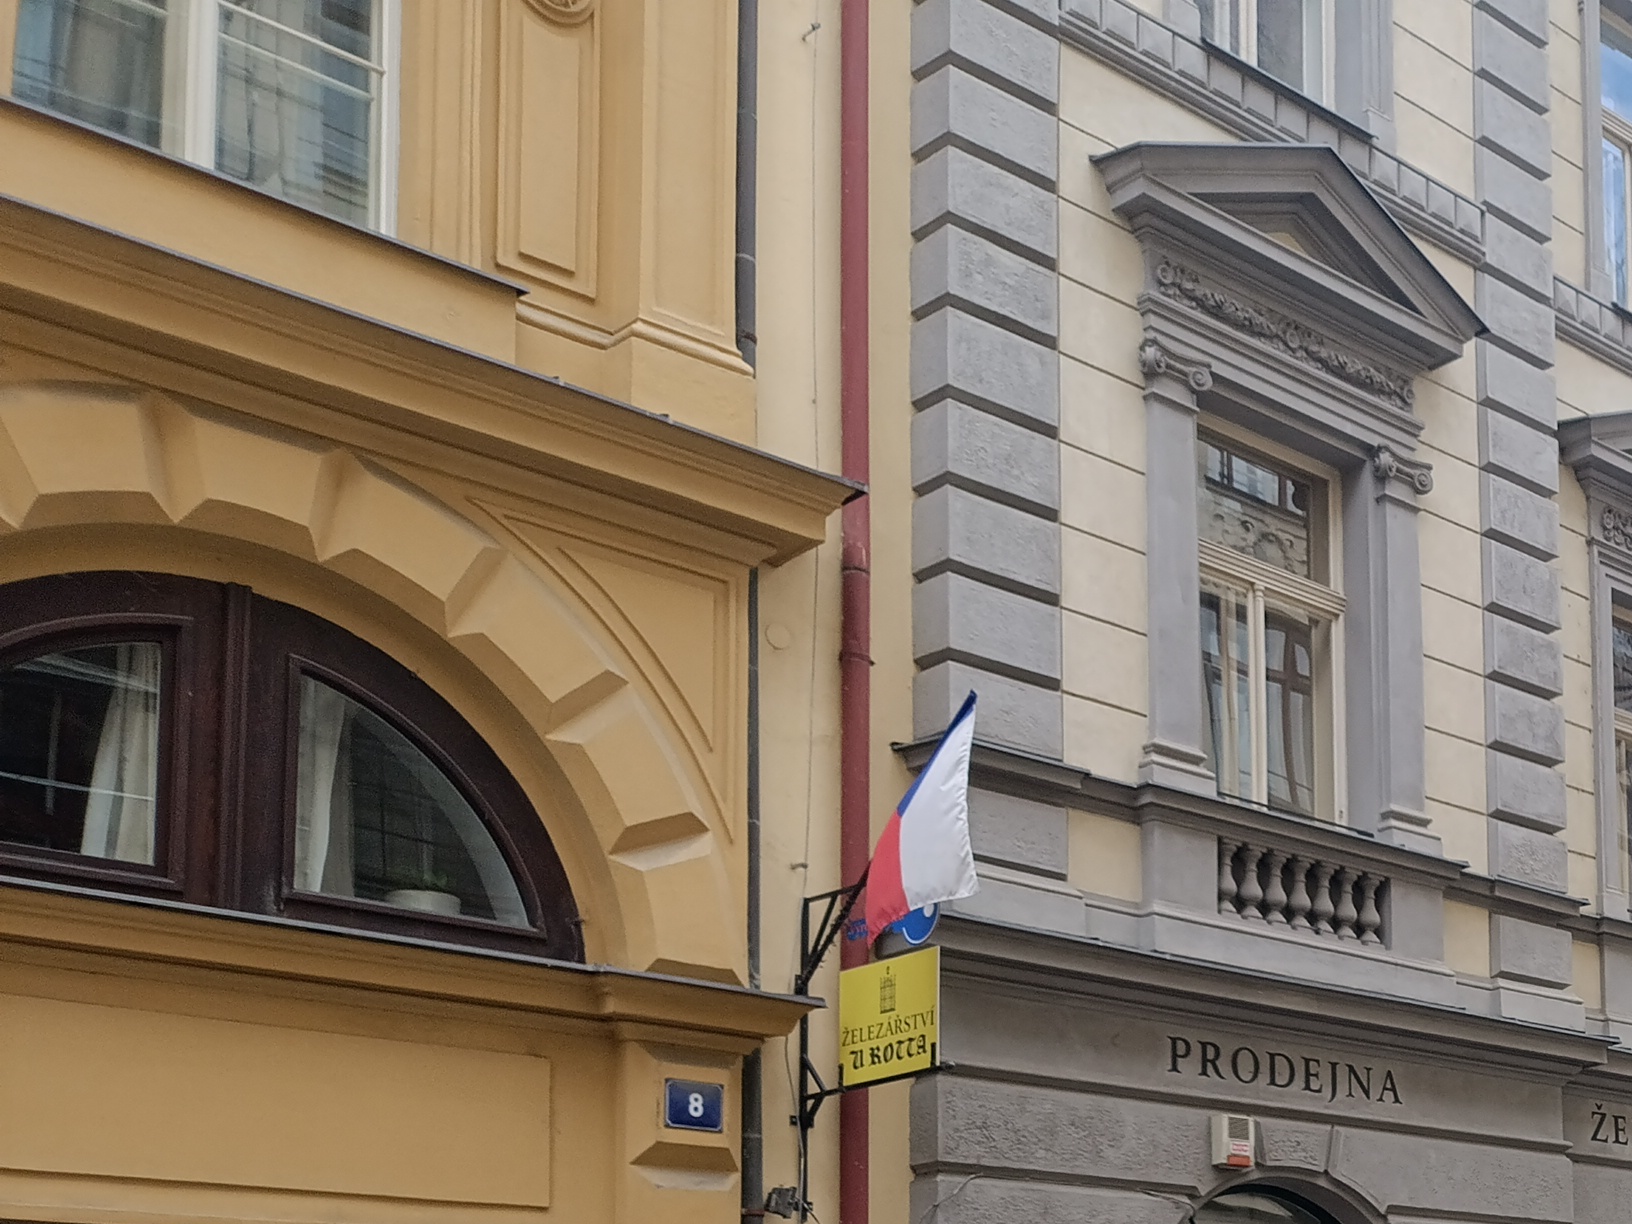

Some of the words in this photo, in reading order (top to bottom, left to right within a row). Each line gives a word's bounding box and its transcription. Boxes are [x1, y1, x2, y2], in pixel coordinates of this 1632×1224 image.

[842, 1005, 935, 1047] ŽELEZÁŘSTVÍ
[849, 1047, 865, 1070] U
[869, 1034, 929, 1067] ROTTA
[1166, 1034, 1404, 1106] PRODEJNA
[688, 1092, 704, 1118] 8
